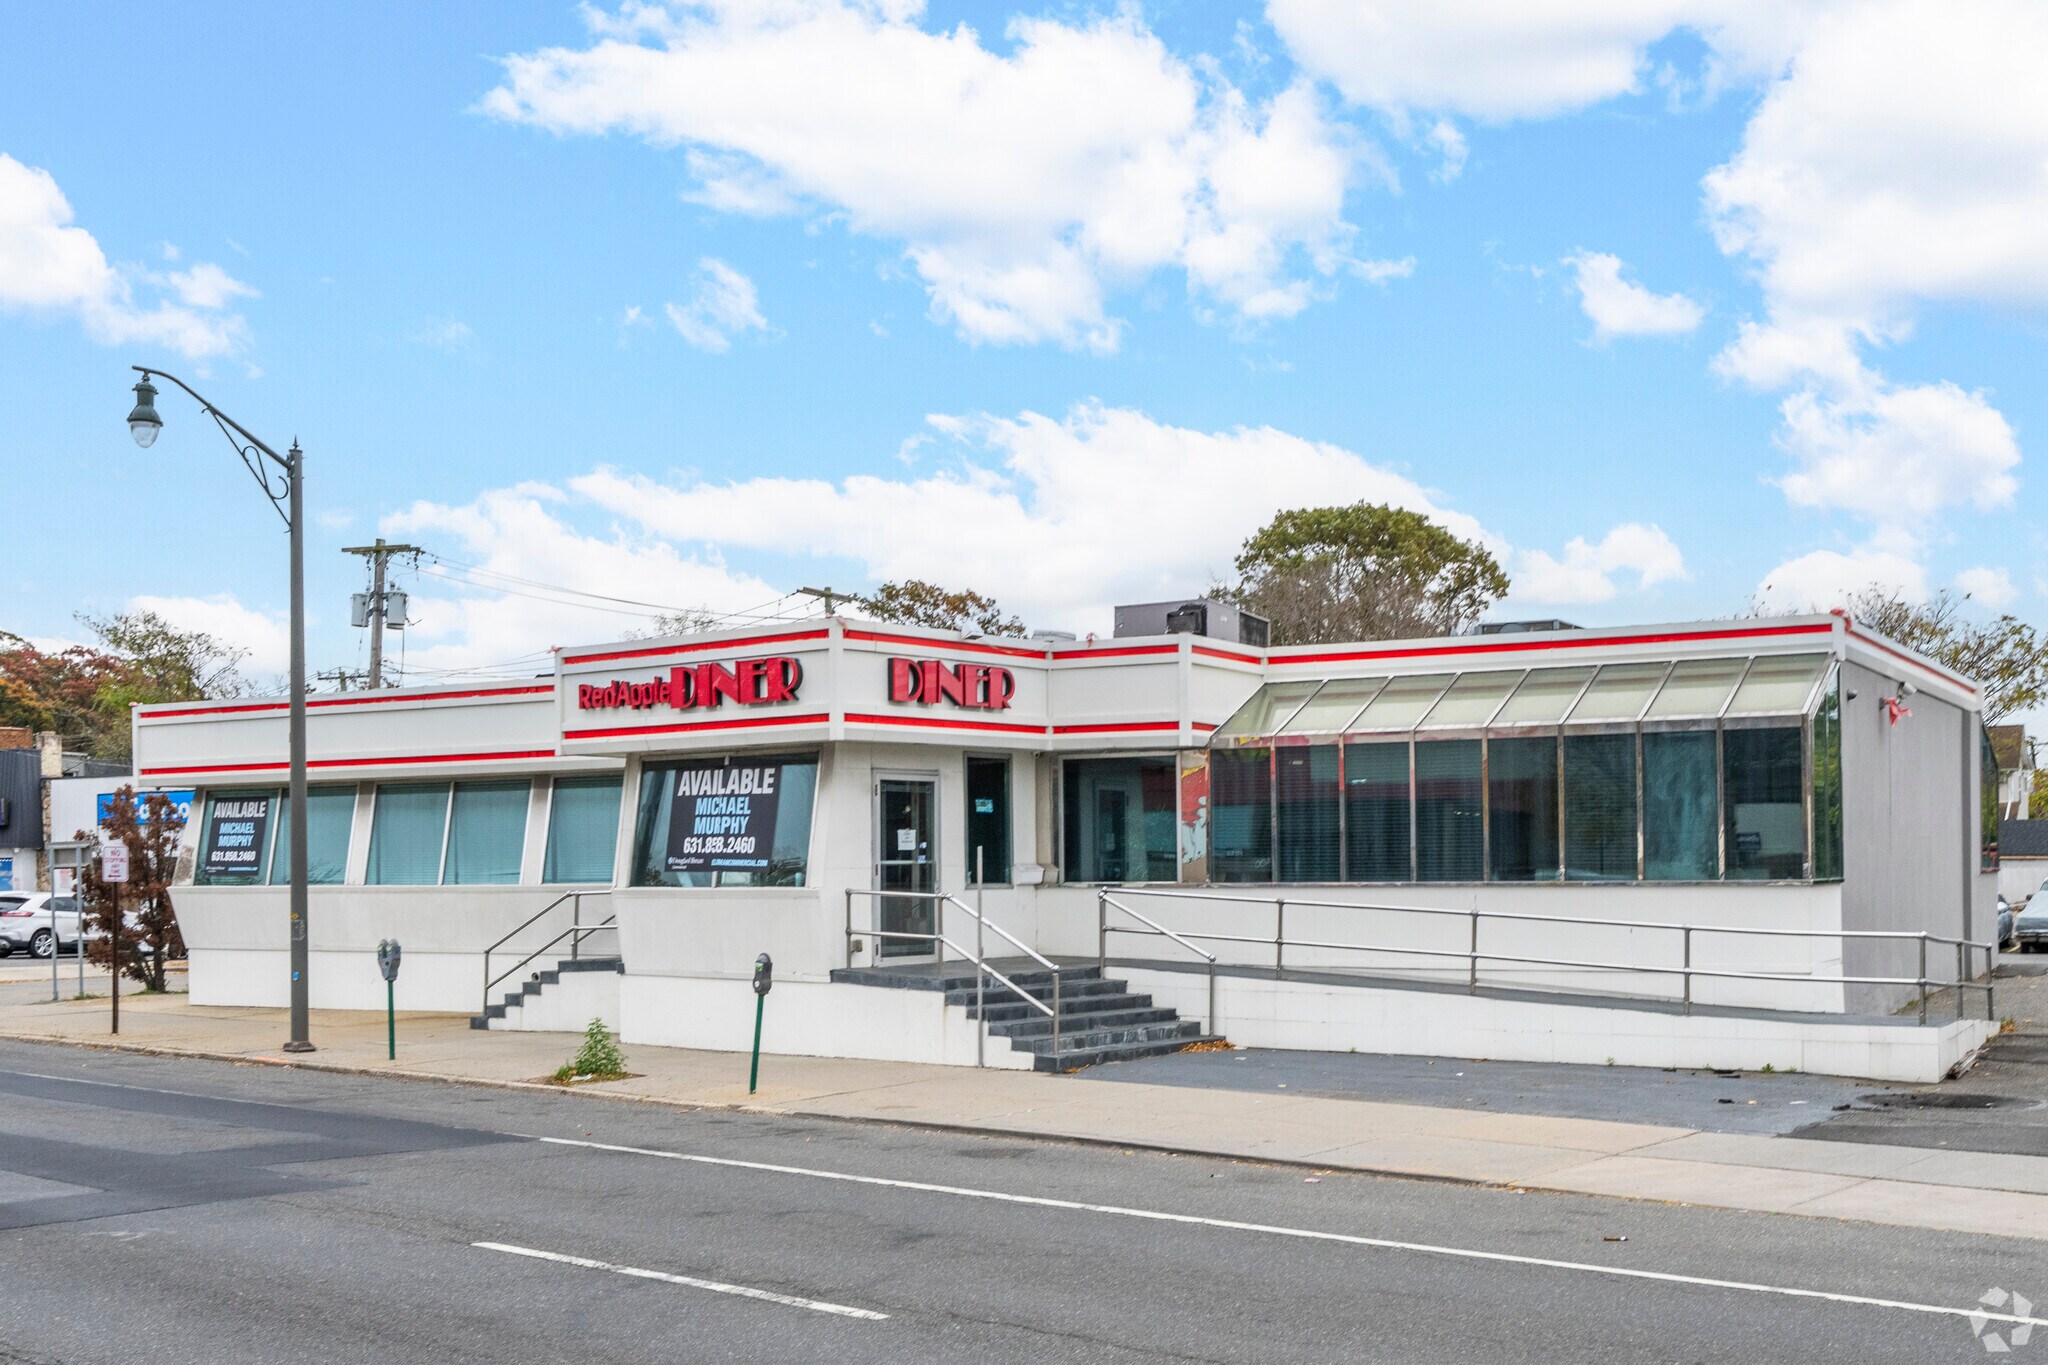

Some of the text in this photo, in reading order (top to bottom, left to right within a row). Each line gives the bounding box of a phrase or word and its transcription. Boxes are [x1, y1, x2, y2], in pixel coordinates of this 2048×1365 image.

[670, 656, 803, 709] DINER
[887, 657, 1015, 709] DINER
[677, 768, 776, 797] AVAILABLE
[213, 801, 267, 818] AVAILABLE
[695, 797, 752, 816] MICHAEL
[219, 822, 255, 835] MICHAEL
[693, 816, 750, 835] MURPHY
[217, 835, 254, 847] MURPHY
[683, 836, 756, 854] 631.858.2460
